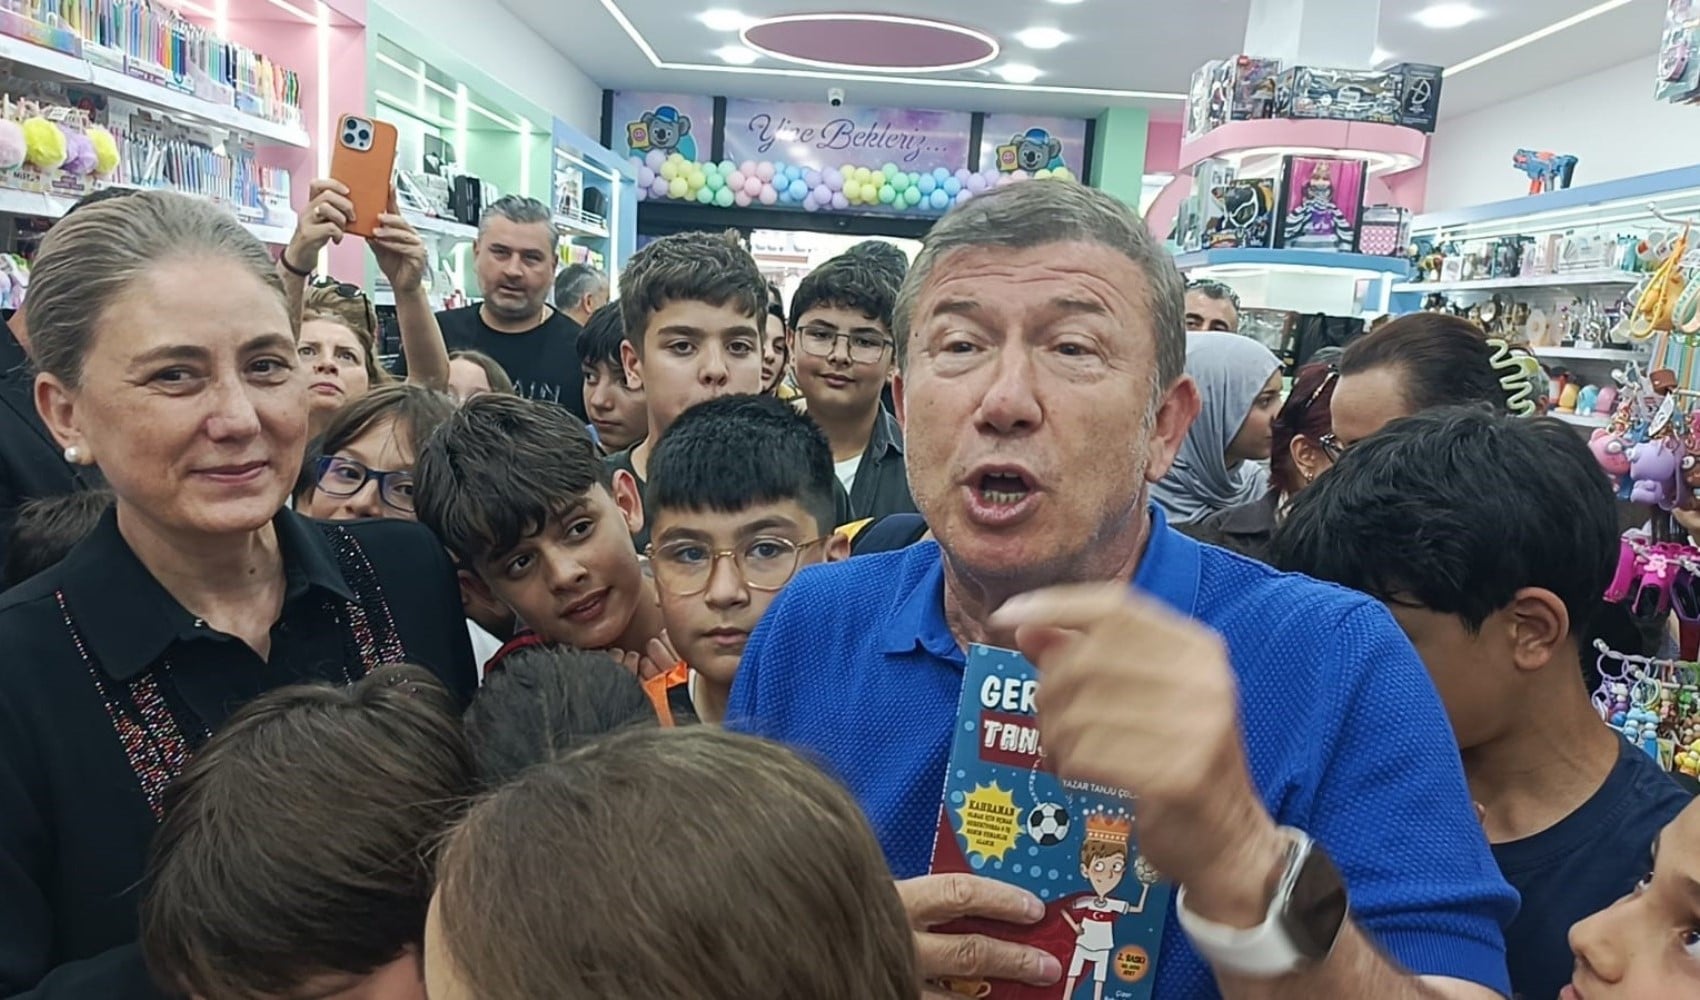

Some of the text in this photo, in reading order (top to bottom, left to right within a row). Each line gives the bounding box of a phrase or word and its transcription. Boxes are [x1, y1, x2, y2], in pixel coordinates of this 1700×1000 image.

[1062, 779, 1089, 791] YAZAR
[1090, 783, 1117, 796] TANJU
[968, 800, 1015, 816] KAHRAMAN
